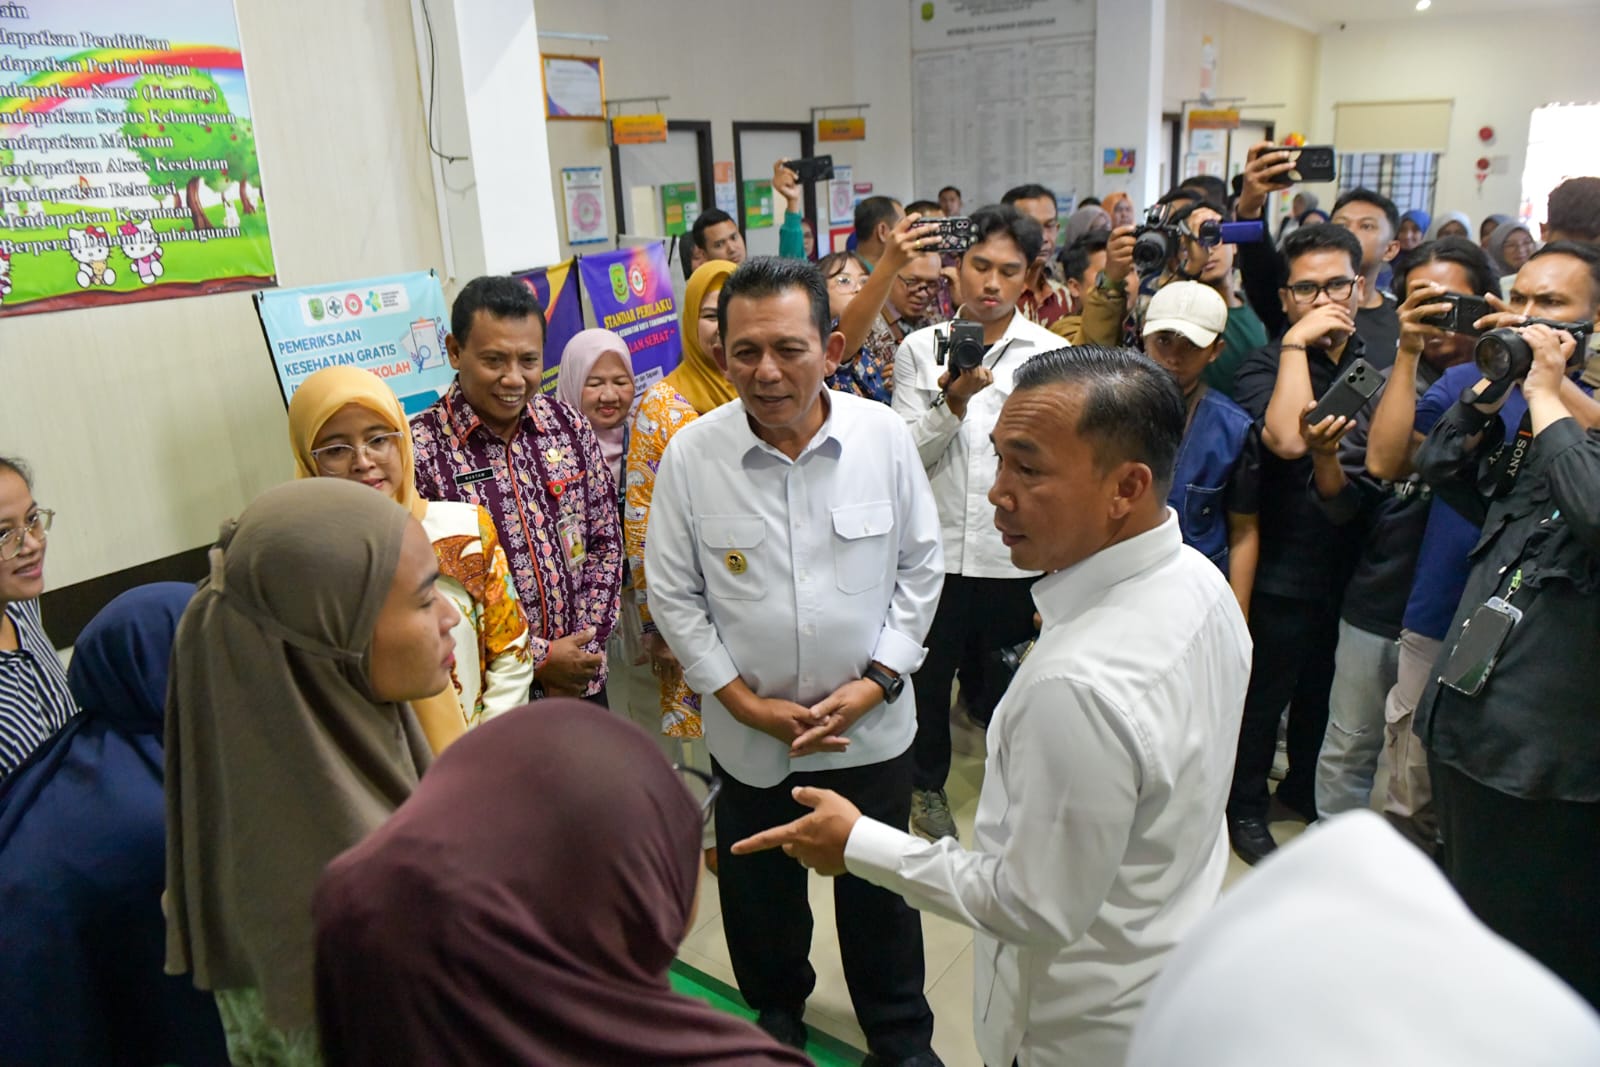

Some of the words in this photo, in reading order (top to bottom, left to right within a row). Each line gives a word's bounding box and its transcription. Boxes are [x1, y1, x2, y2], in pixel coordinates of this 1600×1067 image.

[0, 2, 29, 19] ain
[0, 28, 79, 49] dapatkan
[80, 32, 170, 51] Pendidikan
[1, 54, 82, 76] dapatkan
[87, 57, 190, 77] Perlindungan
[0, 81, 86, 101] ndapatkan
[91, 83, 138, 99] Nama
[142, 84, 218, 102] (Identitas)
[0, 108, 92, 128] ndapatkan
[97, 109, 145, 124] Status
[150, 109, 237, 127] Kebangsaan
[0, 134, 96, 154] endapatkan
[99, 134, 174, 150] Makanan
[0, 159, 102, 179] endapatkan
[106, 158, 150, 173] Akses
[155, 157, 228, 172] Kesehatan
[110, 181, 177, 197] Rekreasi
[114, 206, 192, 222] Kesamaan
[0, 238, 80, 257] Berperan
[83, 232, 134, 248] Dalam
[136, 227, 241, 244] Pembangunan
[604, 309, 635, 330] STANDAR
[635, 298, 673, 320] PERILAKU
[278, 329, 362, 355] PEMERIKSAAN
[284, 352, 355, 376] KESEHATAN
[356, 344, 397, 361] GRATIS
[367, 361, 411, 378] KOLAH
[1506, 439, 1527, 477] SONY
